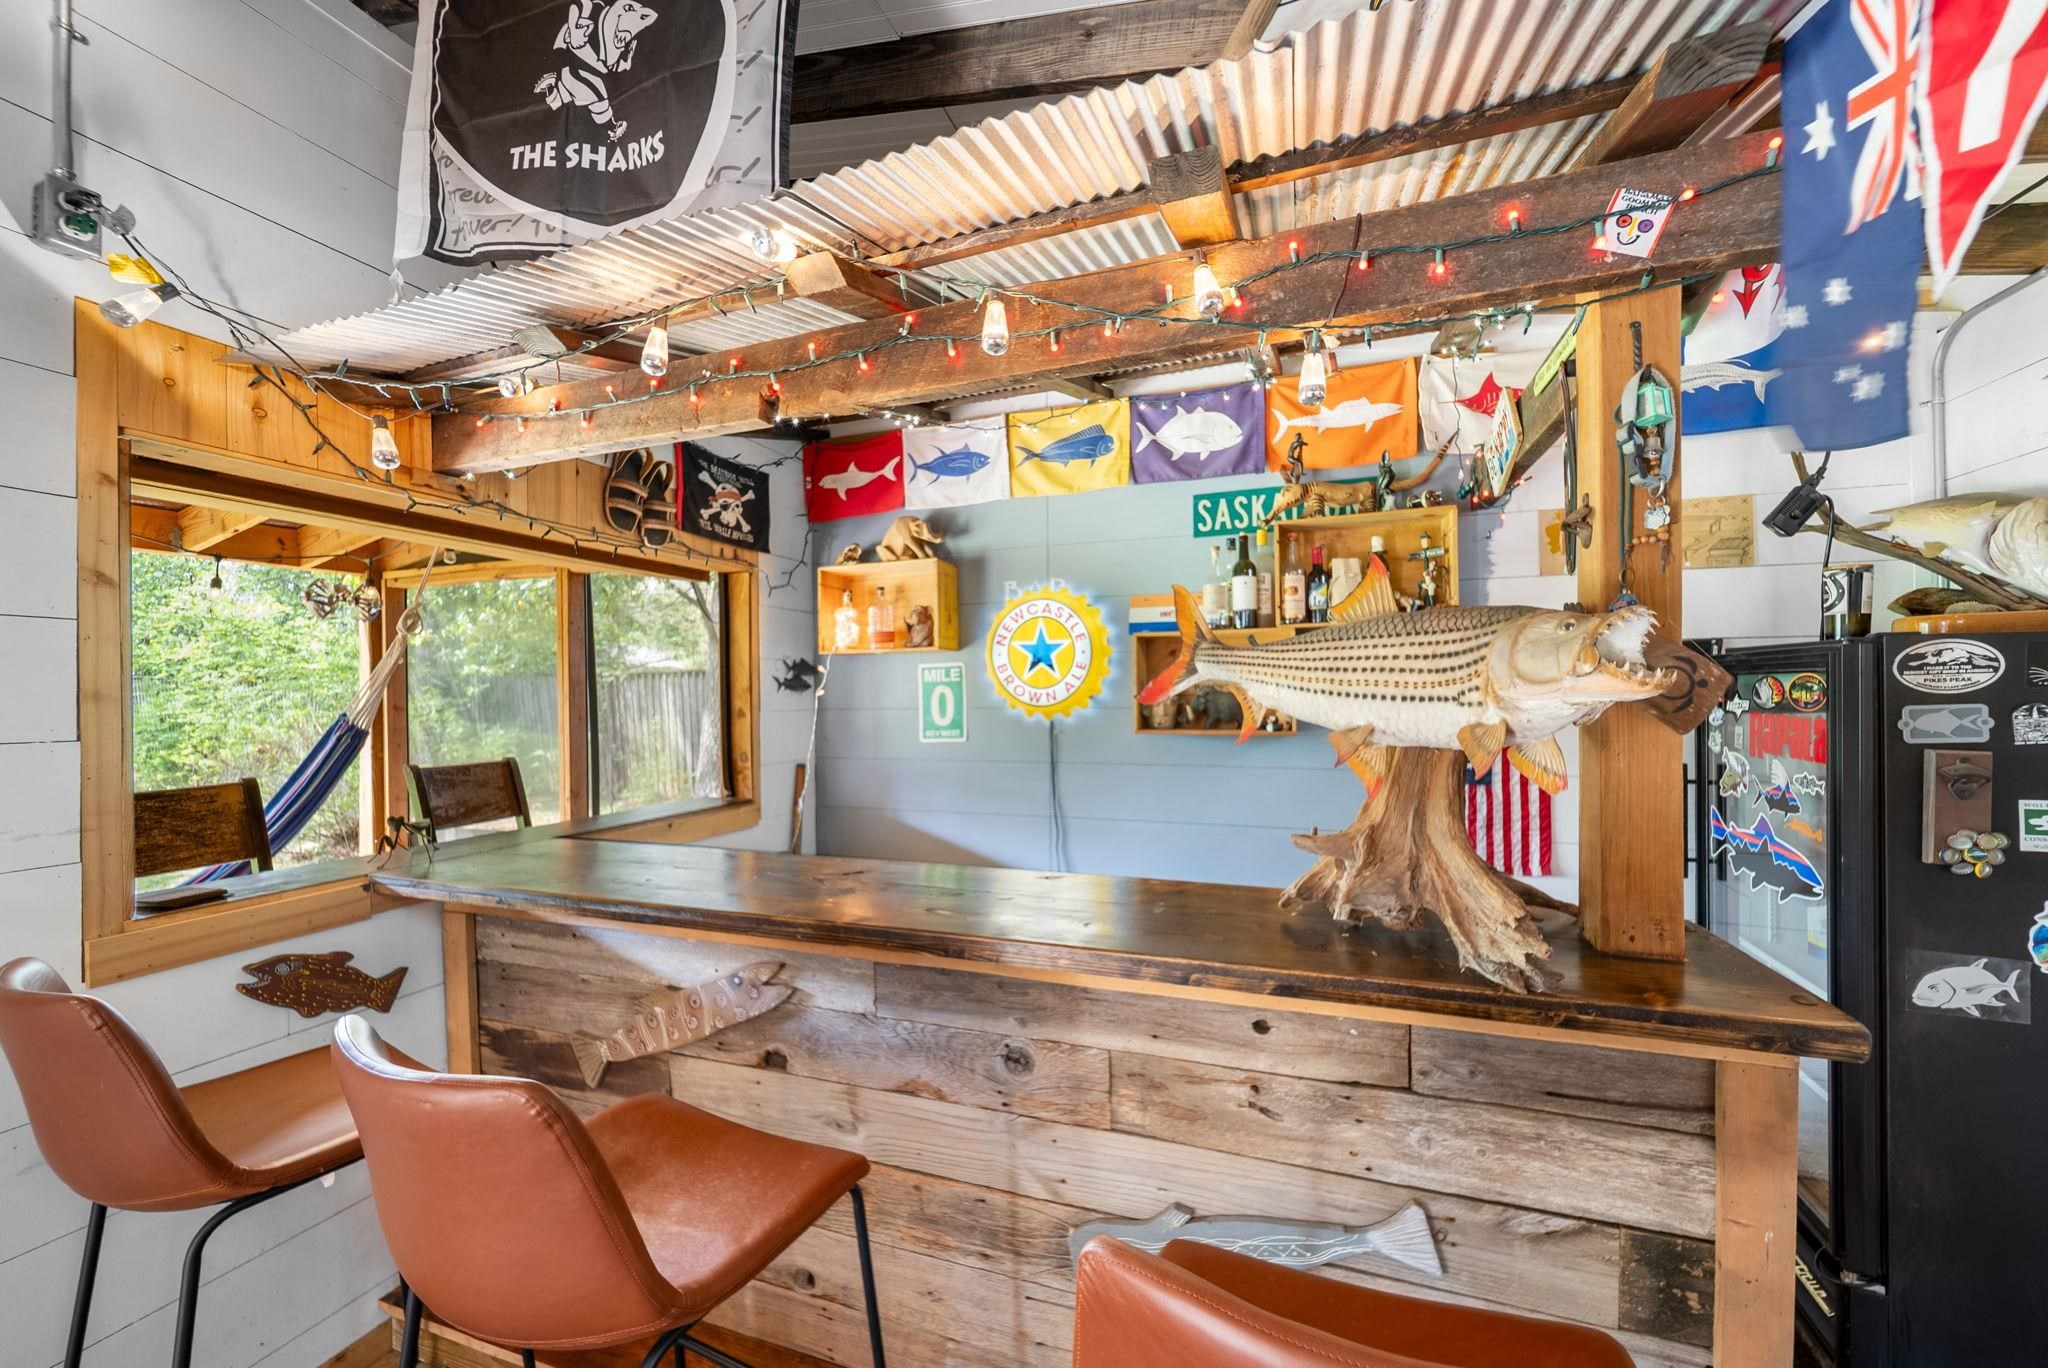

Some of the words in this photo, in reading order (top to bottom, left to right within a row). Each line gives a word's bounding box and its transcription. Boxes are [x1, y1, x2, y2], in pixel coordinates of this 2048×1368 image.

[510, 139, 557, 170] THE
[565, 130, 666, 173] SHARKS
[1622, 195, 1667, 209] GOOMBA
[996, 603, 1087, 646] NEWCASTLE
[923, 667, 961, 682] MILE
[998, 664, 1057, 703] BROWN
[1065, 662, 1087, 693] ALE
[931, 684, 955, 727] 0
